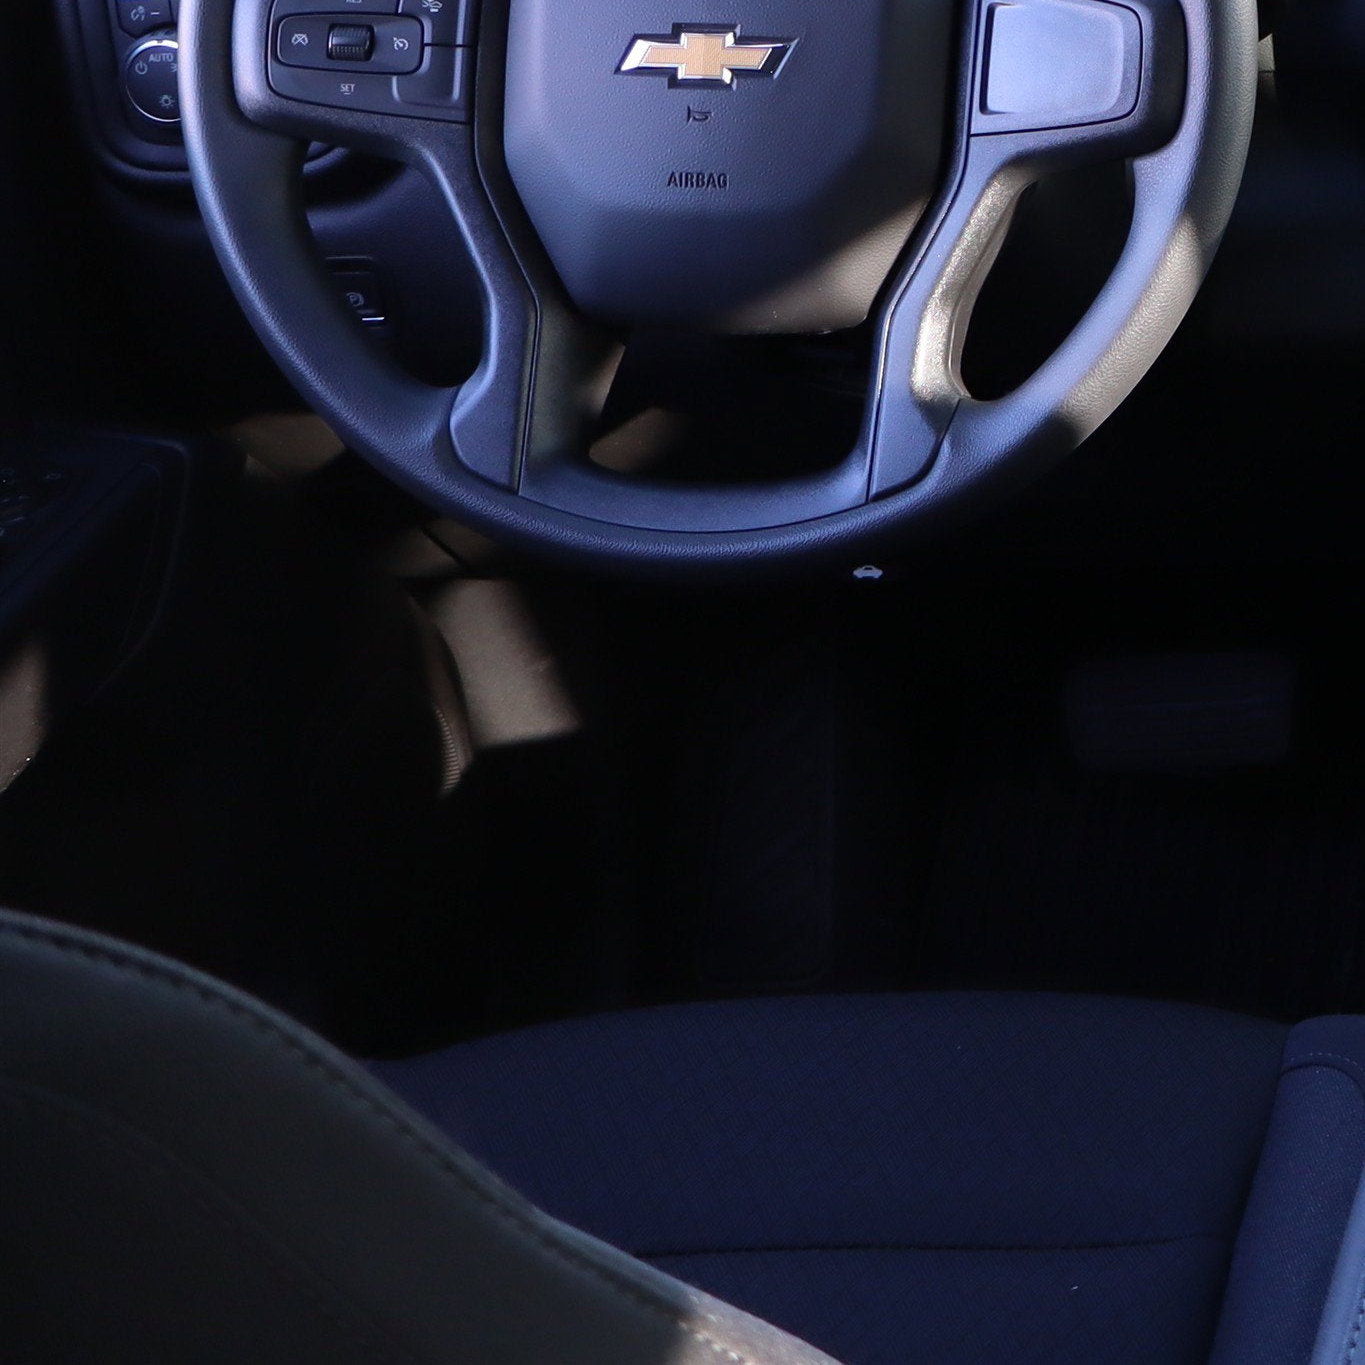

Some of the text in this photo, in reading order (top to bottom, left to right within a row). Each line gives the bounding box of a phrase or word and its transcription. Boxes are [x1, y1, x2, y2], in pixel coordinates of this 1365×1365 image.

[148, 53, 174, 63] AUTO
[340, 84, 356, 93] SET
[667, 171, 730, 189] AIRBAG
